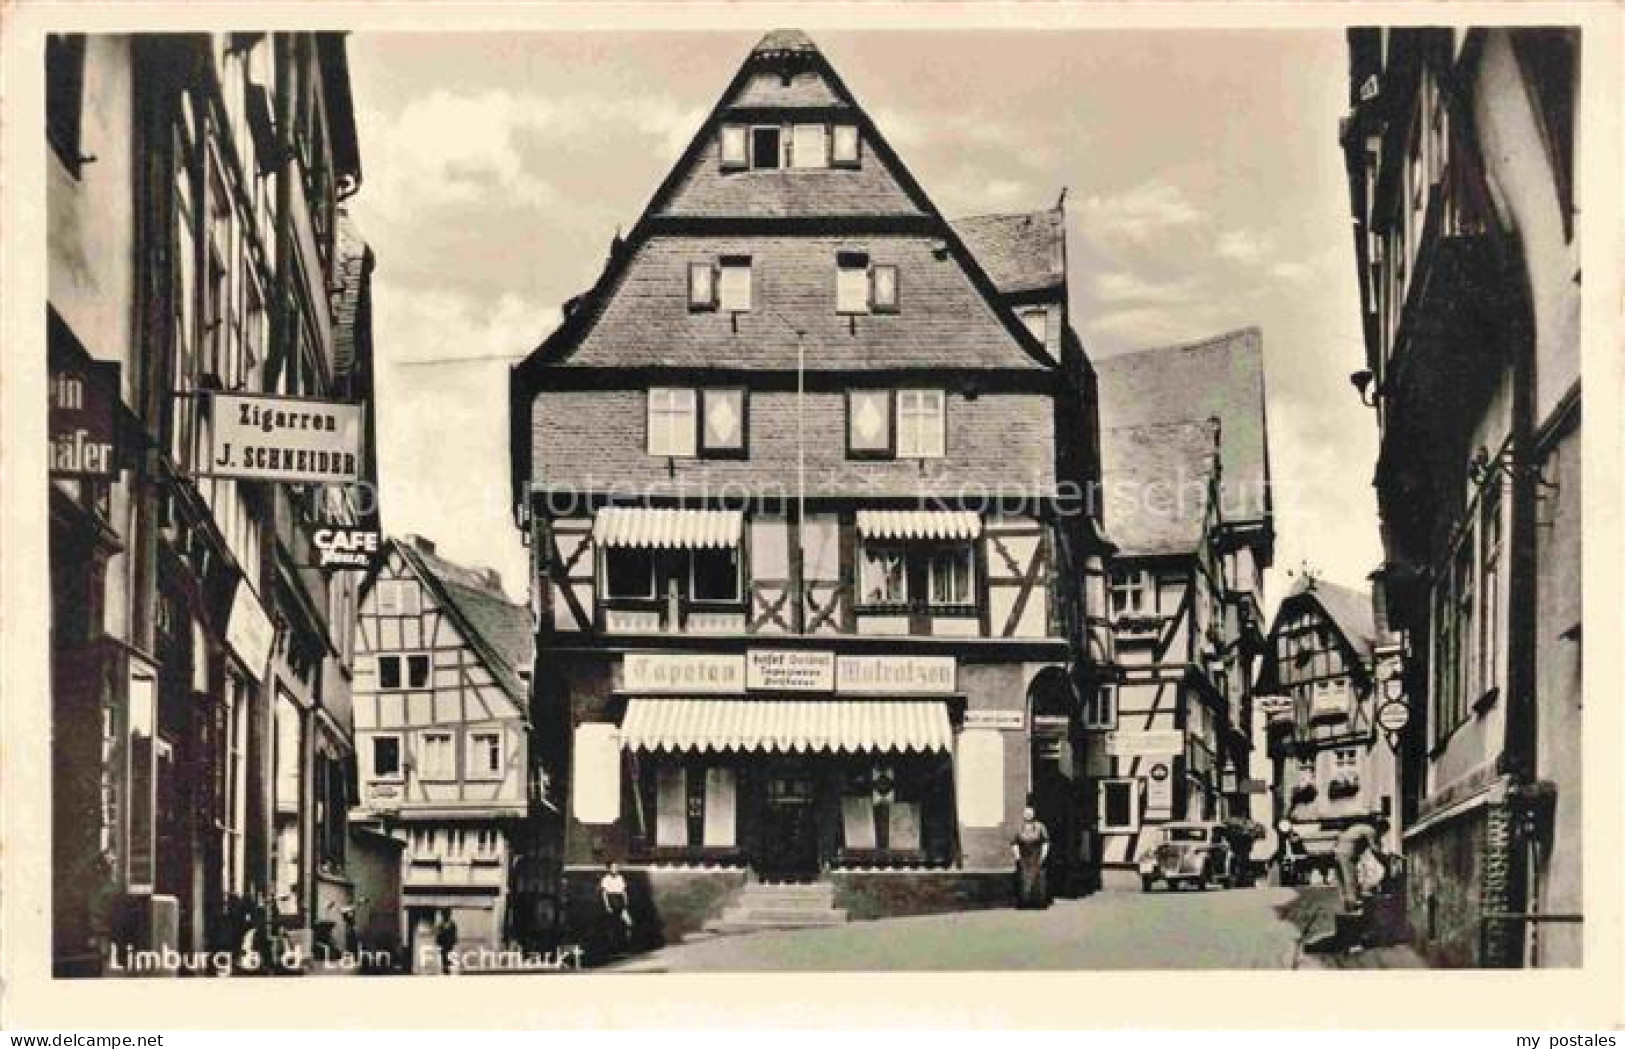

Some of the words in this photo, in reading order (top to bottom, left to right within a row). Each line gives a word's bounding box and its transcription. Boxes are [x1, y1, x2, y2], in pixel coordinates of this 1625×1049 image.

[239, 403, 335, 432] Zigarren
[216, 443, 237, 467] J.
[244, 446, 355, 474] SCHNEIDER
[313, 529, 378, 551] CAFE
